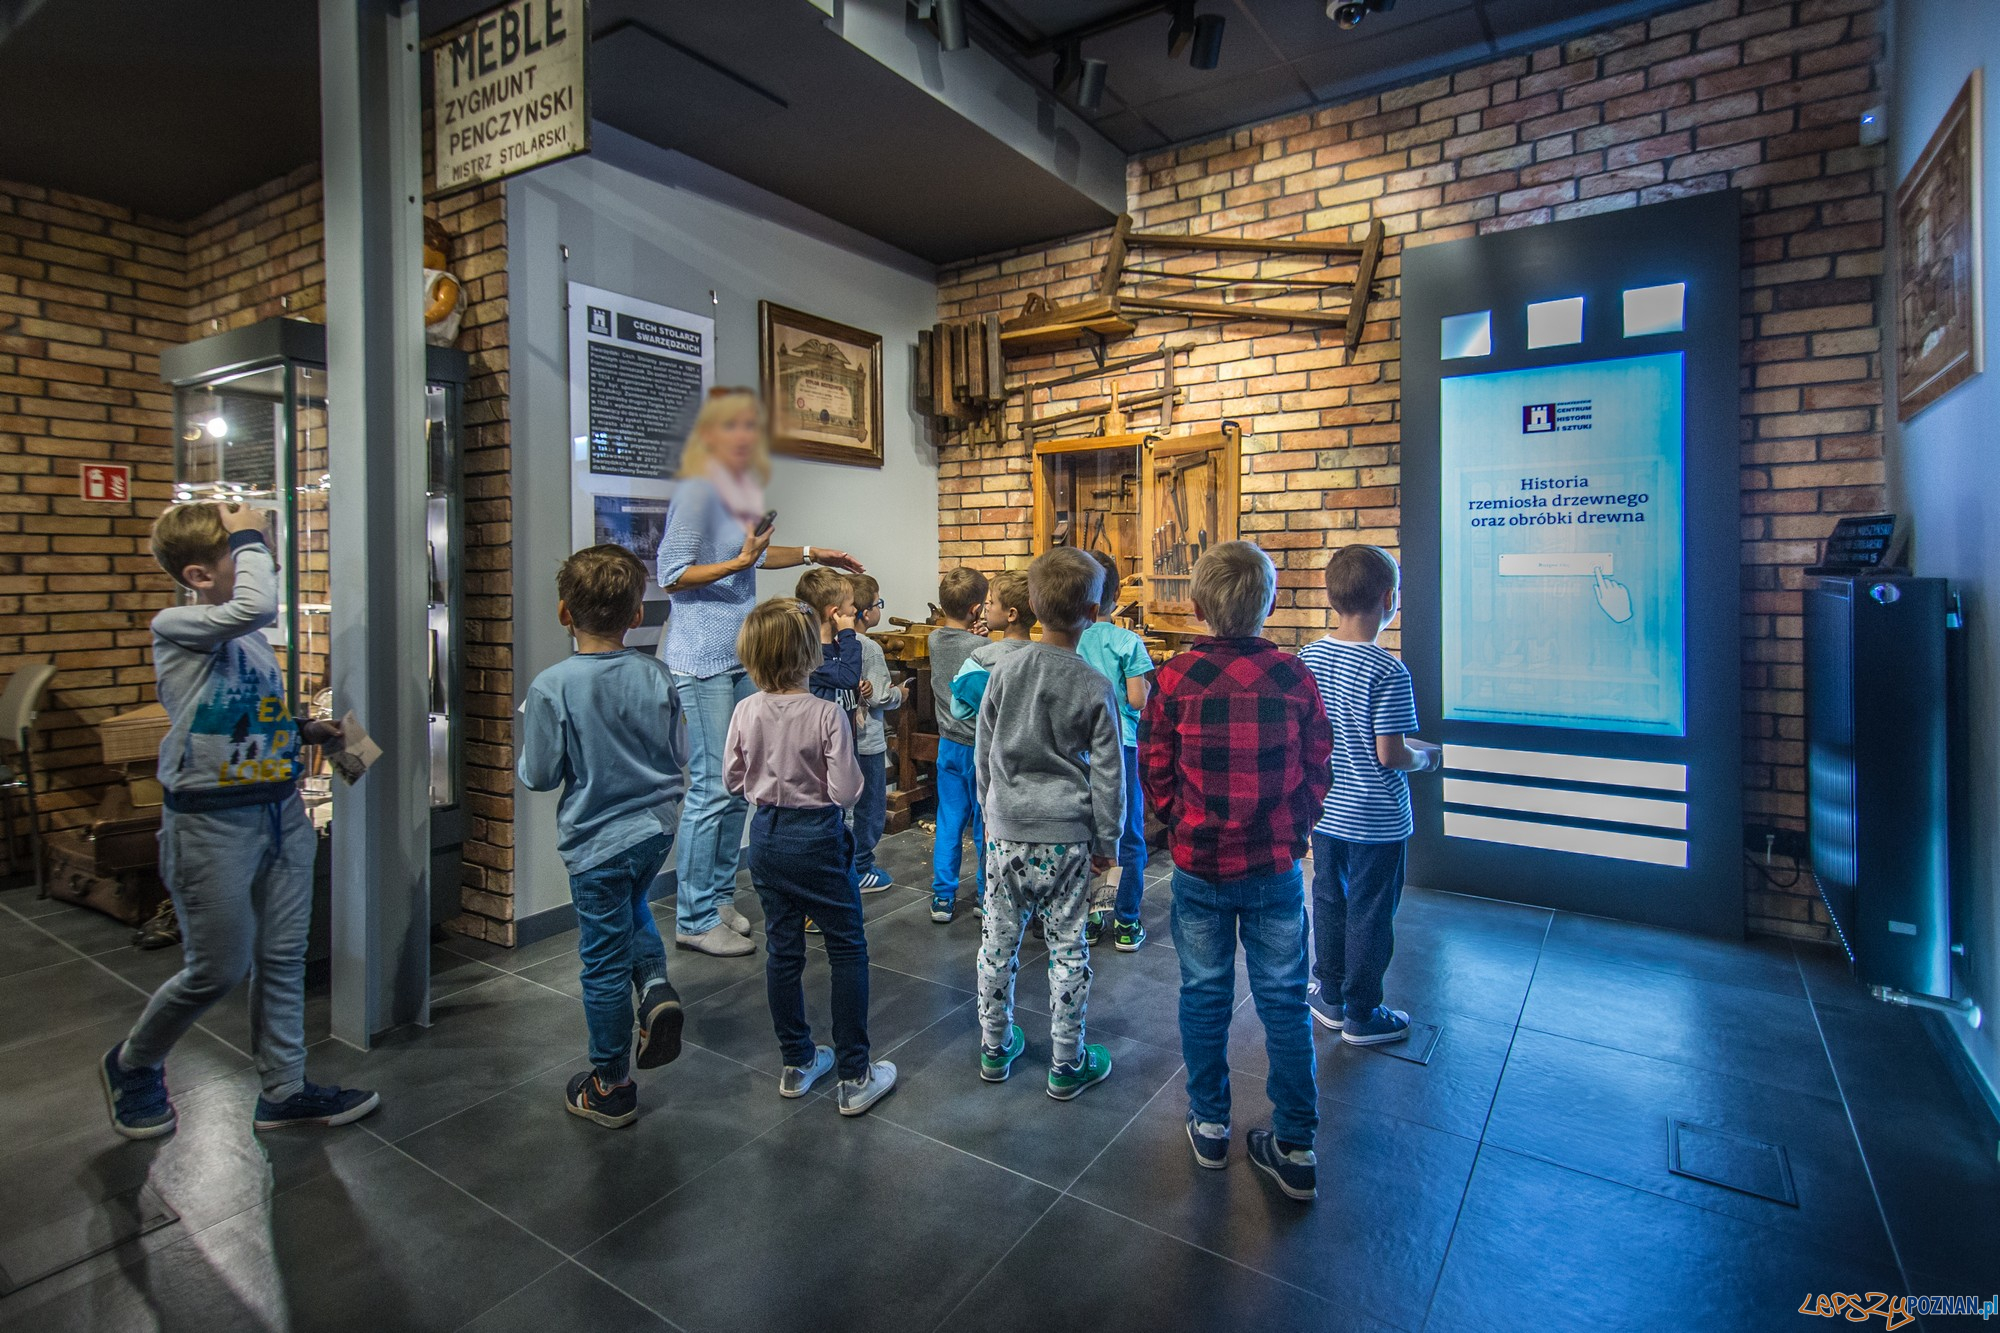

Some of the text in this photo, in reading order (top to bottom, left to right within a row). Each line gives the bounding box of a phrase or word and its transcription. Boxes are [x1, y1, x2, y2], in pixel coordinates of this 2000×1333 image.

[451, 0, 567, 88] MEBLE
[444, 64, 538, 125] ZYGMUNT
[452, 125, 567, 182] MISTRZ STOLARSKI
[633, 320, 700, 343] CECH STOLARZY
[636, 331, 700, 353] SWARZĘDZKICH
[1556, 406, 1592, 414] CENTRUM
[1556, 414, 1592, 422] HISTORII
[1562, 423, 1592, 431] SZTUKI
[1521, 475, 1589, 491] Historia
[1468, 493, 1650, 510] rzemiosła drzewnego
[1471, 511, 1645, 527] oraz obróbki drewna
[258, 697, 292, 722] EX
[271, 730, 289, 754] P
